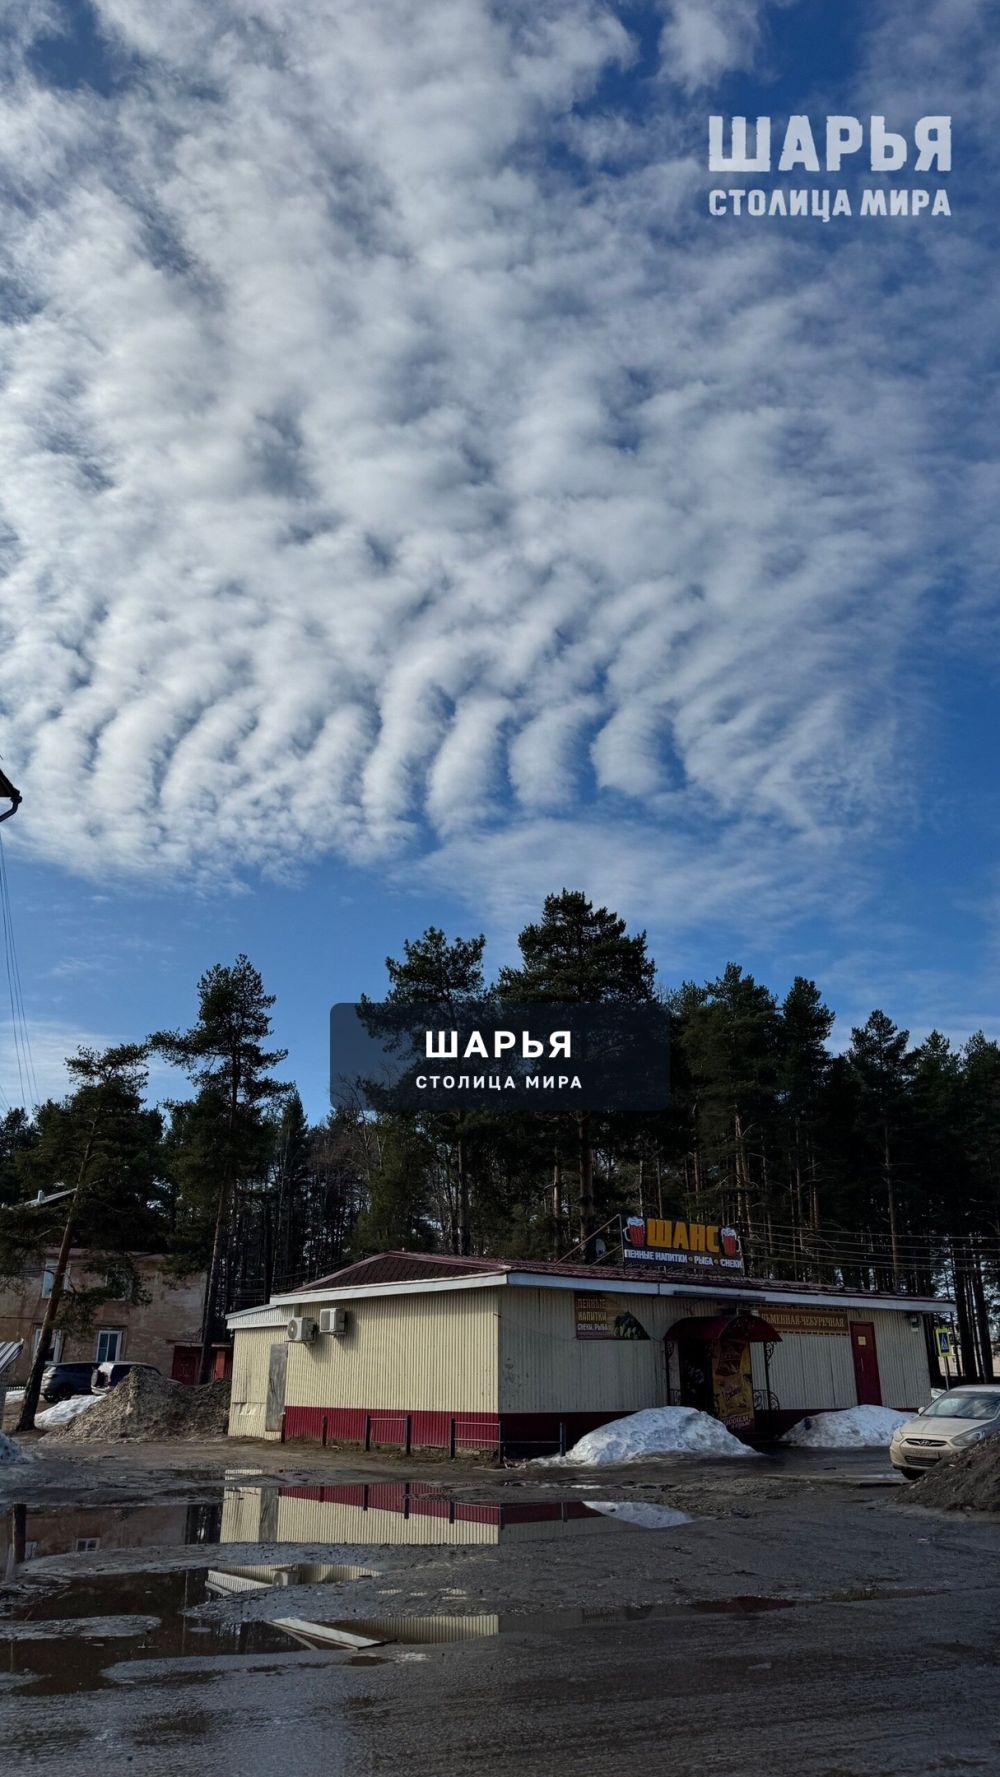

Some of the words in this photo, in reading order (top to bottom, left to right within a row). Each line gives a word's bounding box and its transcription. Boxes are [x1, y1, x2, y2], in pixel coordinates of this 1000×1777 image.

[646, 1218, 720, 1253] ШАНС
[624, 1249, 654, 1260] ПЕННЫЕ
[655, 1252, 688, 1263] НАПИТКИ
[694, 1255, 714, 1266] РЫБА
[720, 1258, 743, 1268] СНЕКИ
[577, 1311, 607, 1321] НАПИТКИ
